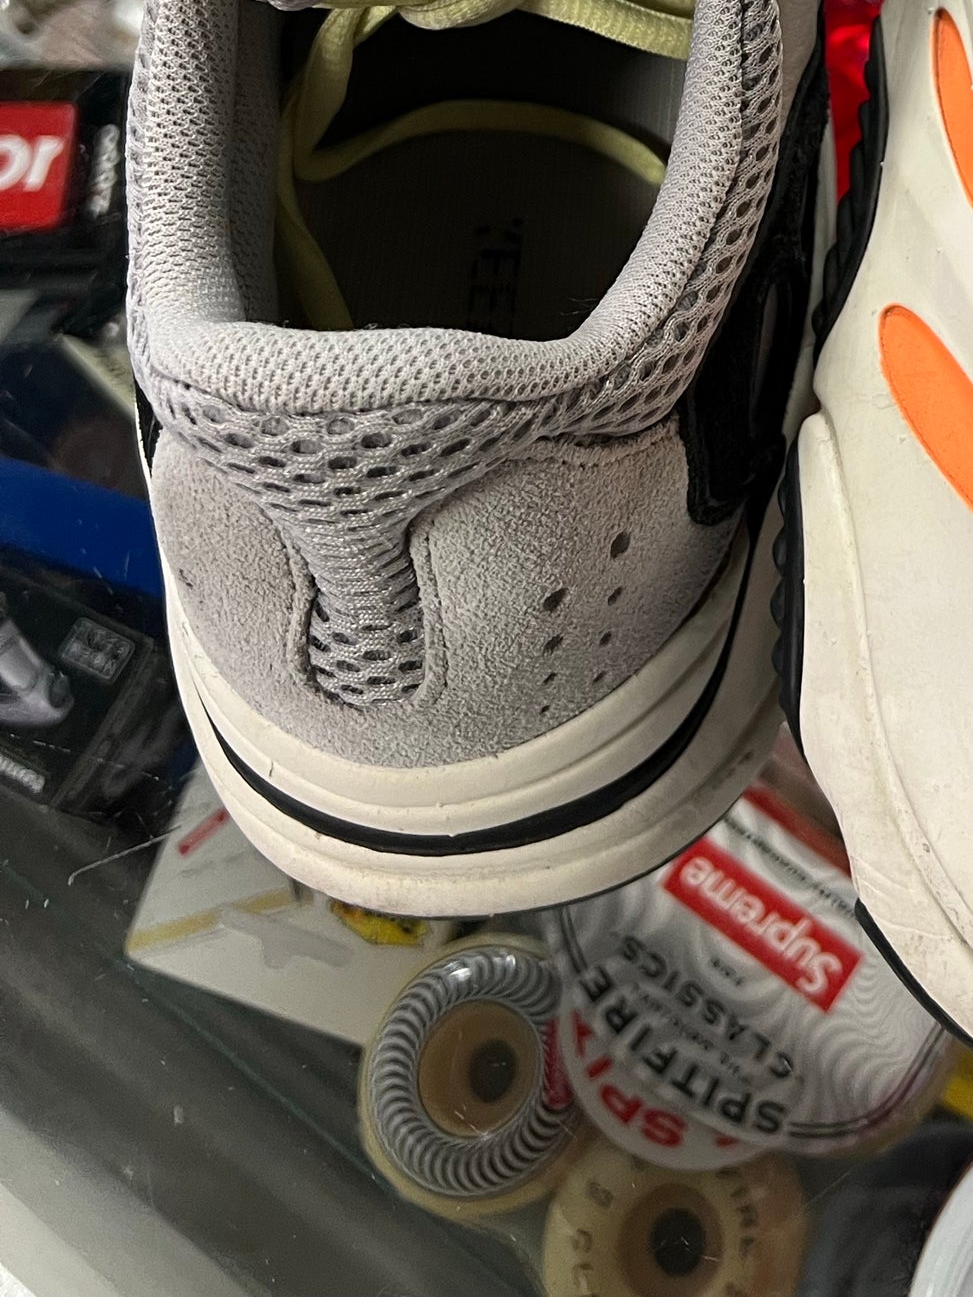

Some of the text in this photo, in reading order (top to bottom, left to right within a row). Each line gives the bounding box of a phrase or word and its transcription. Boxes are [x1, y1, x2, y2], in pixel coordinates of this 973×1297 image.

[678, 855, 843, 994] Supreme
[579, 965, 787, 1134] SPITFIRE
[621, 935, 794, 1078] CLASSICS
